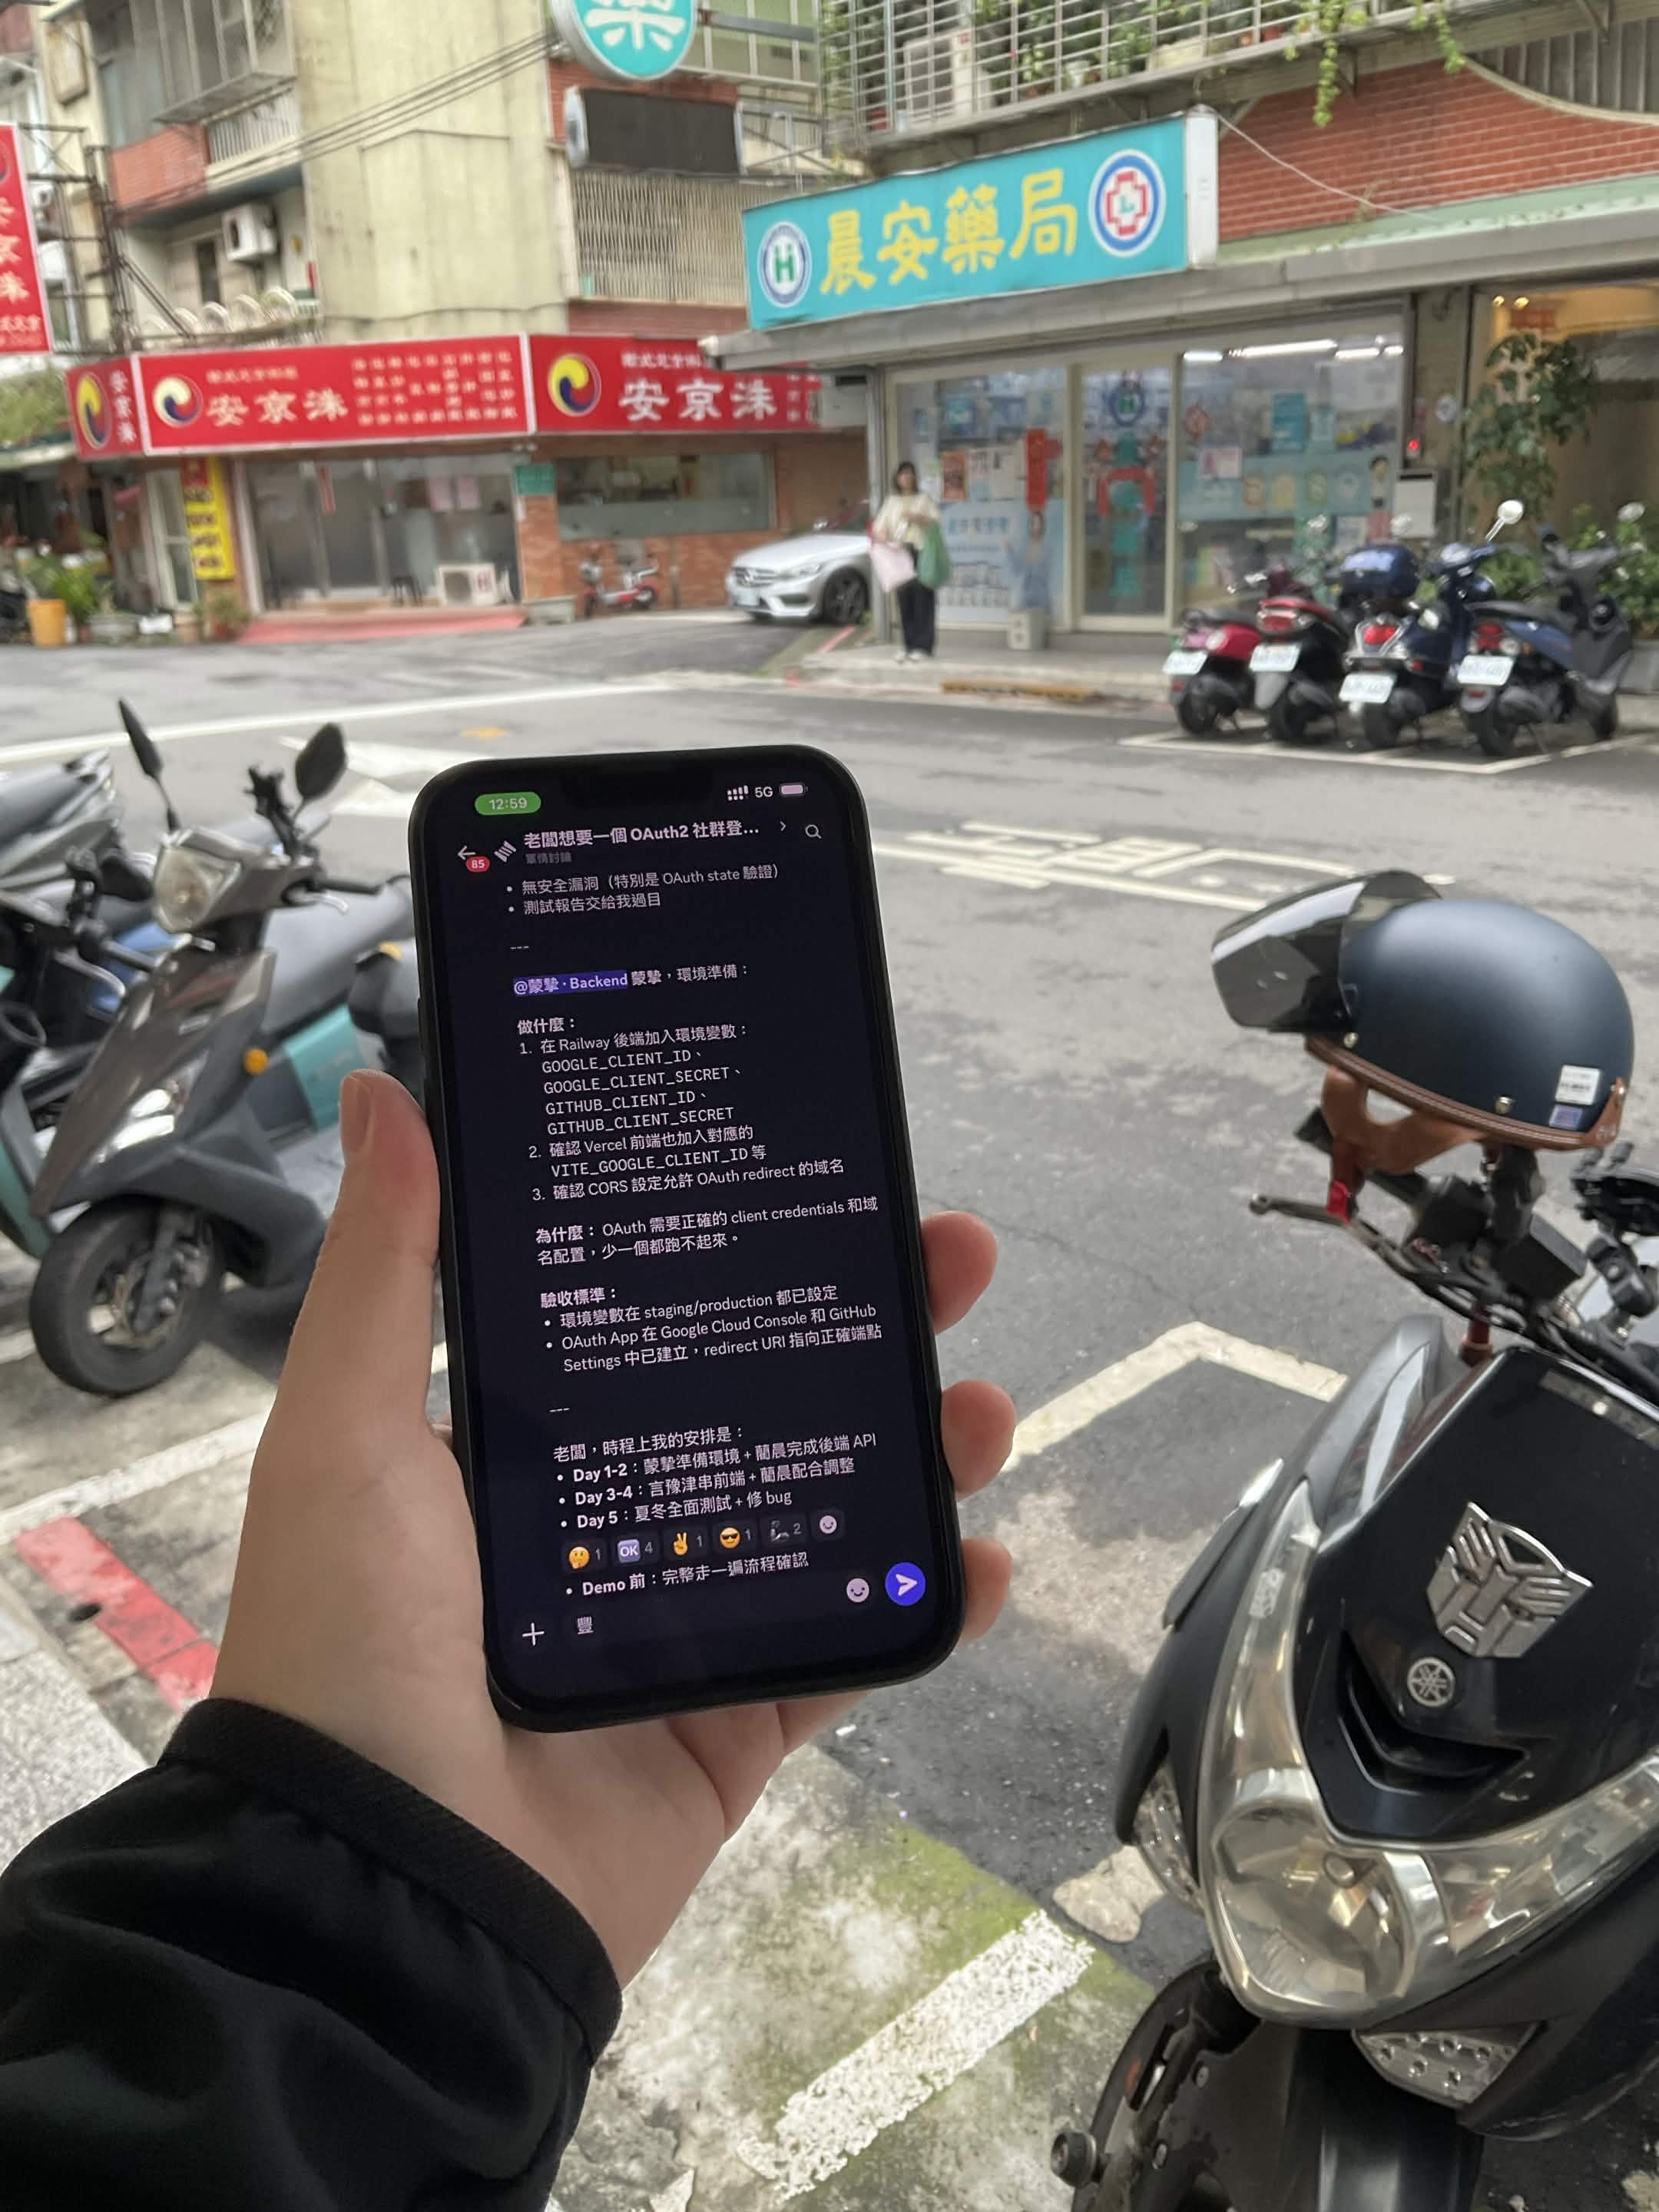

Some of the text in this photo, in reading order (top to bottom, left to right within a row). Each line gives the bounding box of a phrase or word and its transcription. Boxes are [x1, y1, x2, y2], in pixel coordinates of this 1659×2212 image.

[819, 167, 1078, 296] 晨安藥局
[488, 796, 528, 810] 12:59
[755, 786, 773, 798] 5G
[523, 827, 628, 849] 老闆想要一個
[630, 825, 689, 841] OAuth2
[471, 859, 485, 869] 85
[663, 870, 704, 885] OAuth
[707, 869, 740, 882] state
[524, 892, 661, 915] 測試報告交給我過目
[569, 972, 628, 989] Backend
[519, 1042, 532, 1055] 1.
[540, 1038, 557, 1055] 在
[558, 1037, 611, 1051] Railway
[547, 1107, 734, 1135] GITHUB_CLIENT_SECRET
[528, 1124, 753, 1158] 2. 確認 Vercel 前端也加入對應的
[551, 1144, 767, 1177] VITE_GOOGLE_CLIENT_ID 等
[532, 1159, 844, 1201] 3. 確認 CORS 設定允許 OAuth redirect 的域名
[602, 1220, 647, 1237] OAuth
[649, 1210, 727, 1233] 需要正確的
[730, 1209, 769, 1224] client
[771, 1200, 845, 1220] credentials
[847, 1196, 879, 1214] 和域
[559, 1284, 839, 1329] 環境變數在 staging/production 都已設定
[561, 1303, 876, 1349] OAuth App 在 Google Cloud Console 和 GitHub
[564, 1356, 621, 1372] Settings
[761, 1335, 786, 1350] URI
[788, 1323, 882, 1349] 指向正確端點
[573, 1469, 601, 1483] Day
[853, 1432, 876, 1449] API
[575, 1492, 603, 1506] Day
[577, 1515, 605, 1529] Day
[747, 1491, 763, 1508] 修
[766, 1490, 793, 1505] bug
[644, 1541, 654, 1554] 4
[793, 1522, 802, 1535] 2
[582, 1581, 626, 1596] Demo
